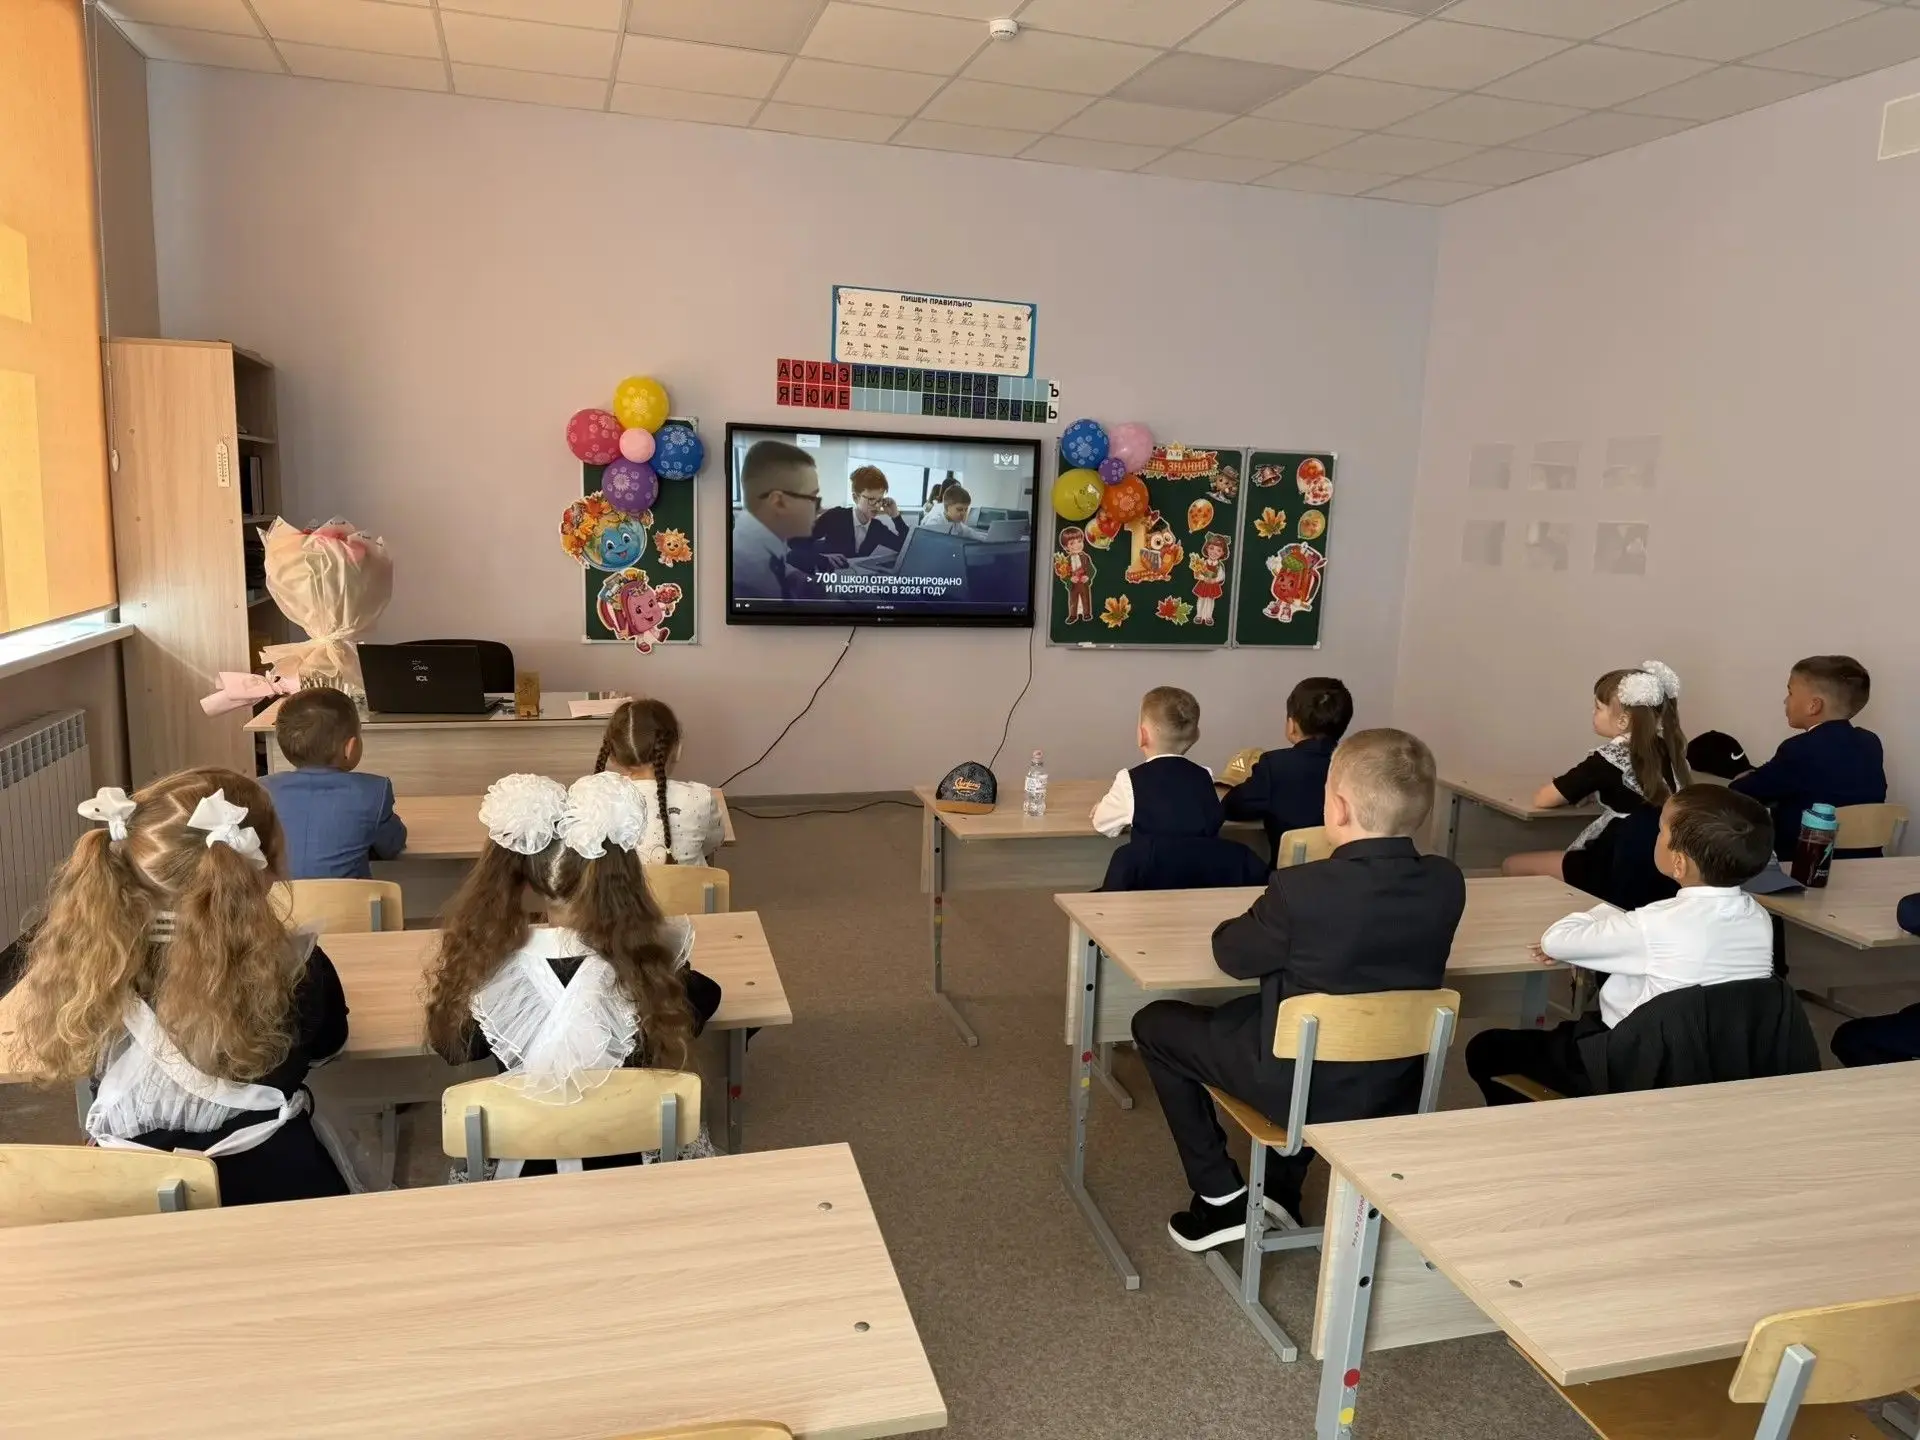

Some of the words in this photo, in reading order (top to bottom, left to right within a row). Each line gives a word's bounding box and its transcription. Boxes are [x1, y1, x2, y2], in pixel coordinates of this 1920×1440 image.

[901, 295, 927, 304] ПИШЕМ
[929, 298, 972, 308] ПРАВИЛЬНО
[1146, 460, 1165, 471] ЕНЬ
[1167, 458, 1209, 472] ЗНАНИЙ
[815, 572, 837, 584] 700
[841, 575, 869, 585] ШКОЛ
[870, 575, 962, 586] ОТРЕМОНТИРОВАНО
[825, 585, 833, 593] И
[835, 585, 890, 594] ПОСТРОЕНО
[892, 586, 898, 594] В
[900, 586, 921, 594] 2026
[923, 586, 947, 596] ГОДУ
